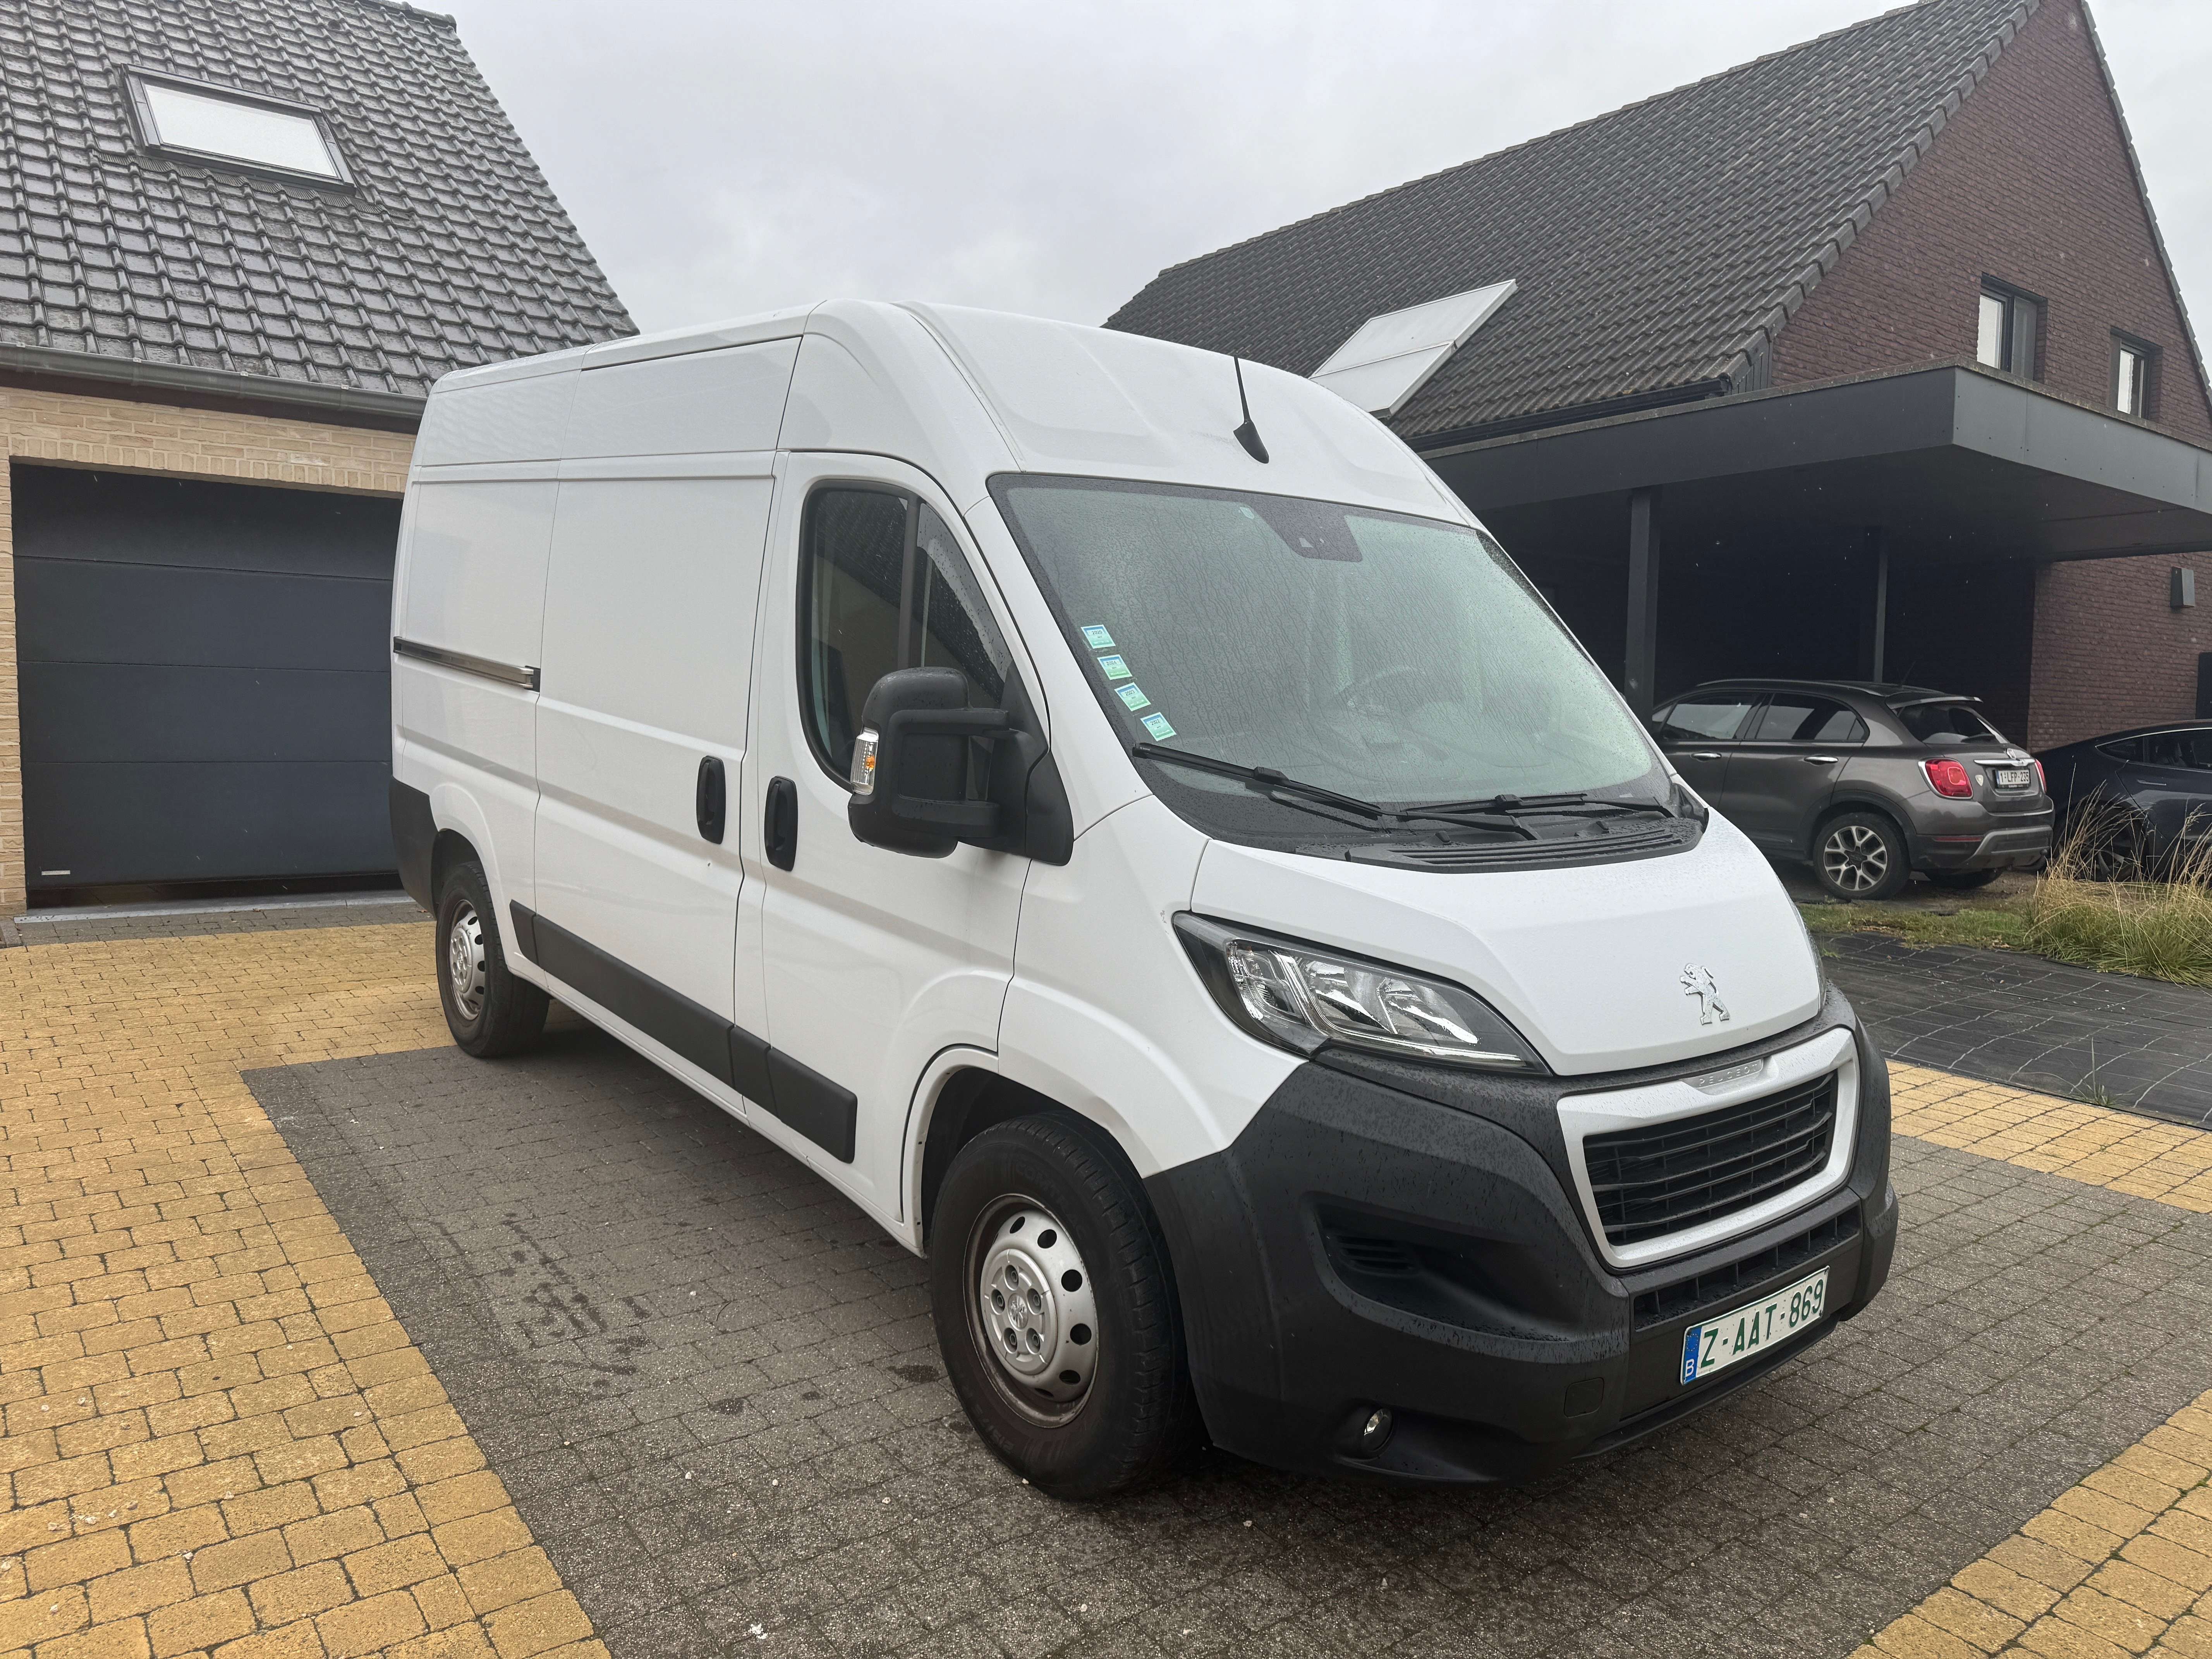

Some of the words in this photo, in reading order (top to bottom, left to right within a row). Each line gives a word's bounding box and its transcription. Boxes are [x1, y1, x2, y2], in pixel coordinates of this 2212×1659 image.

[1699, 1064, 1757, 1086] PEUGEOT
[1700, 1279, 1824, 1369] Z-AAT-869
[1685, 1358, 1694, 1377] B
